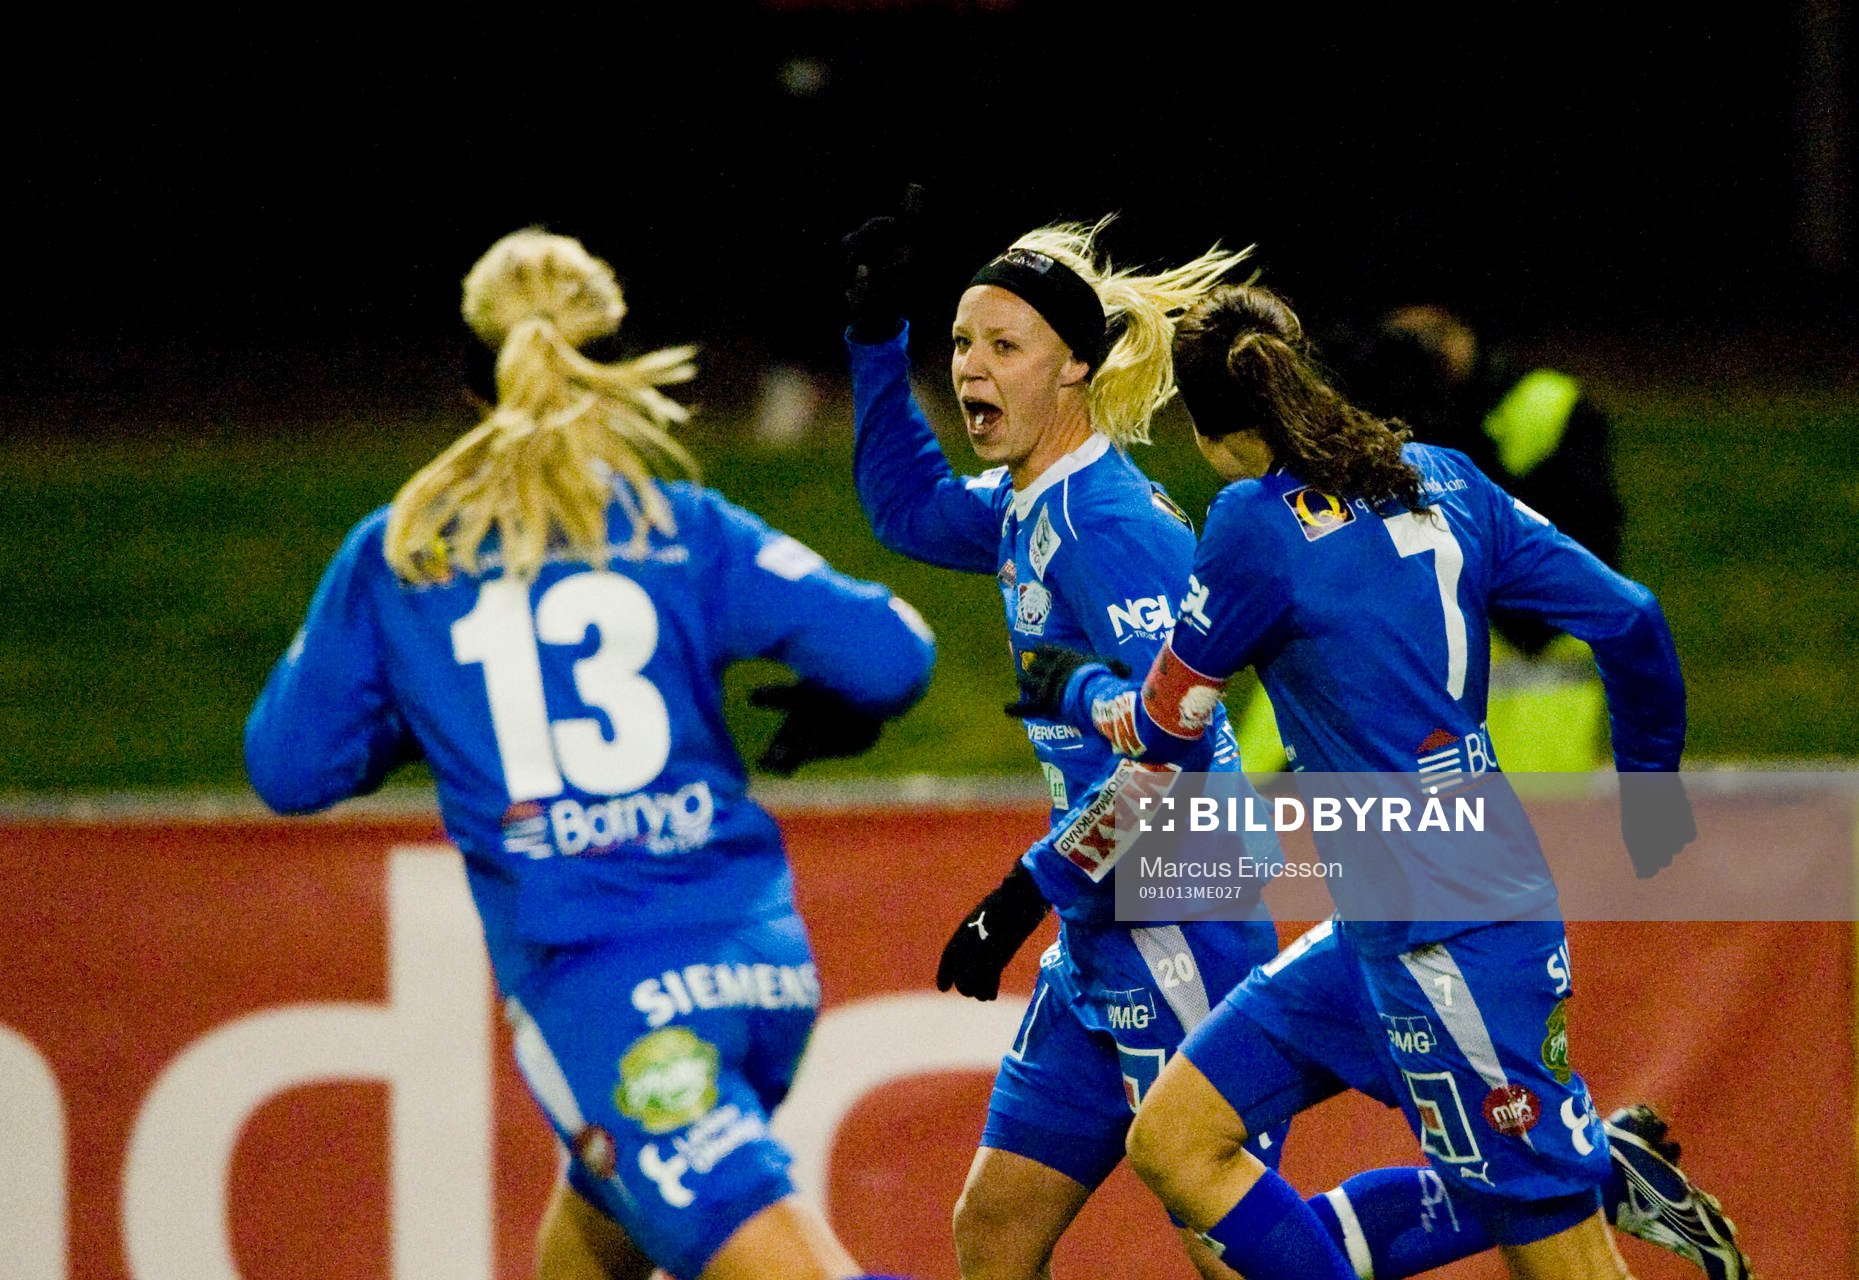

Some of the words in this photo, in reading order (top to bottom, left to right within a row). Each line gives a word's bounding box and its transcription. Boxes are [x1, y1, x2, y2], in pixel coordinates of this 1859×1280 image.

[1383, 504, 1467, 700] 7
[451, 570, 671, 801] 13
[1028, 723, 1074, 740] VERKEN
[1158, 953, 1194, 988] 20
